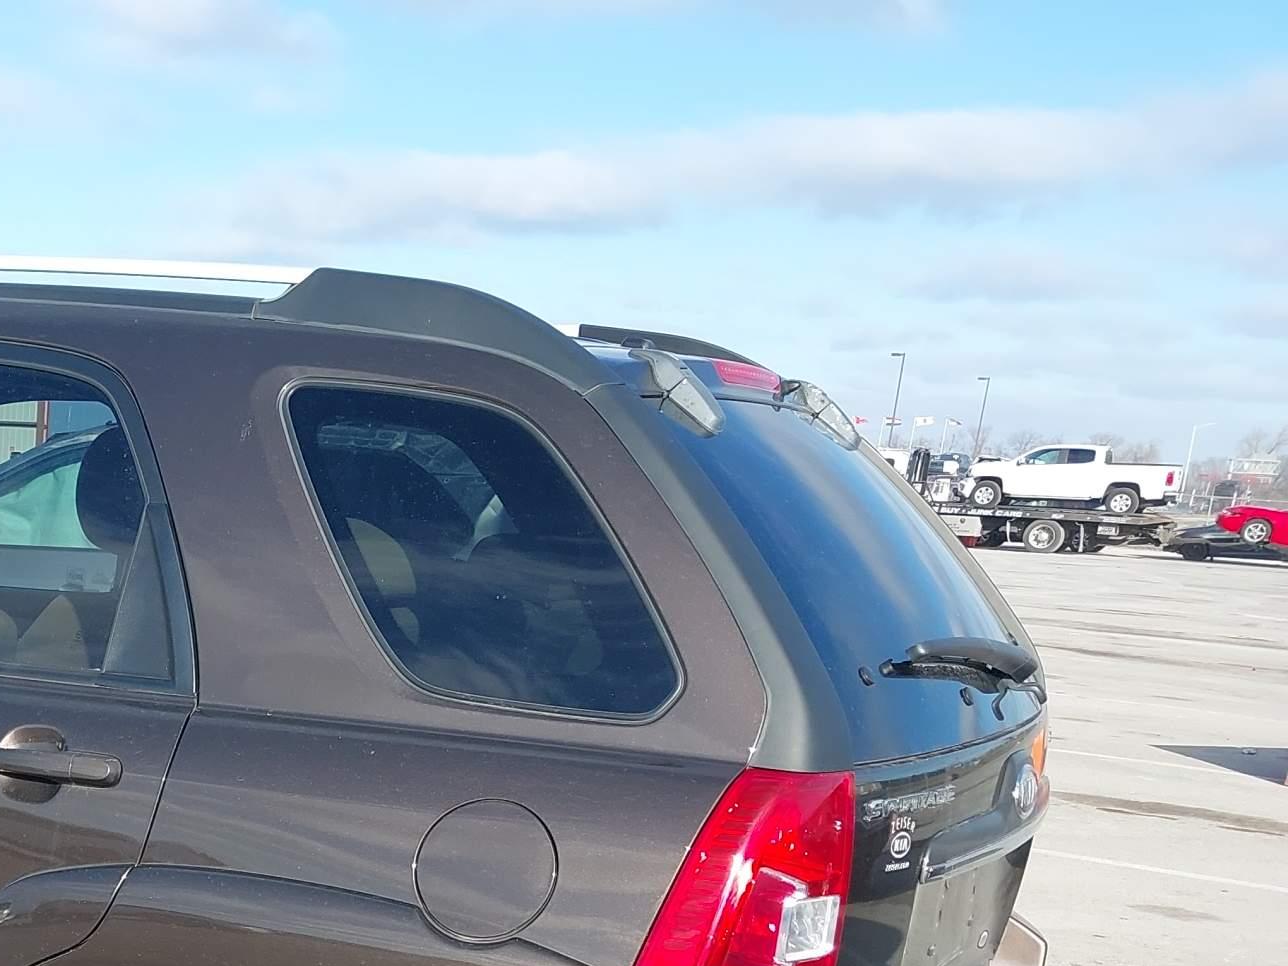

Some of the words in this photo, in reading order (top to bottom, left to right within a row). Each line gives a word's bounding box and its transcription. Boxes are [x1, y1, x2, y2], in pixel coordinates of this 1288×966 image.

[940, 506, 960, 514] BUY
[891, 816, 916, 833] ZEISER
[892, 837, 910, 853] KIA
